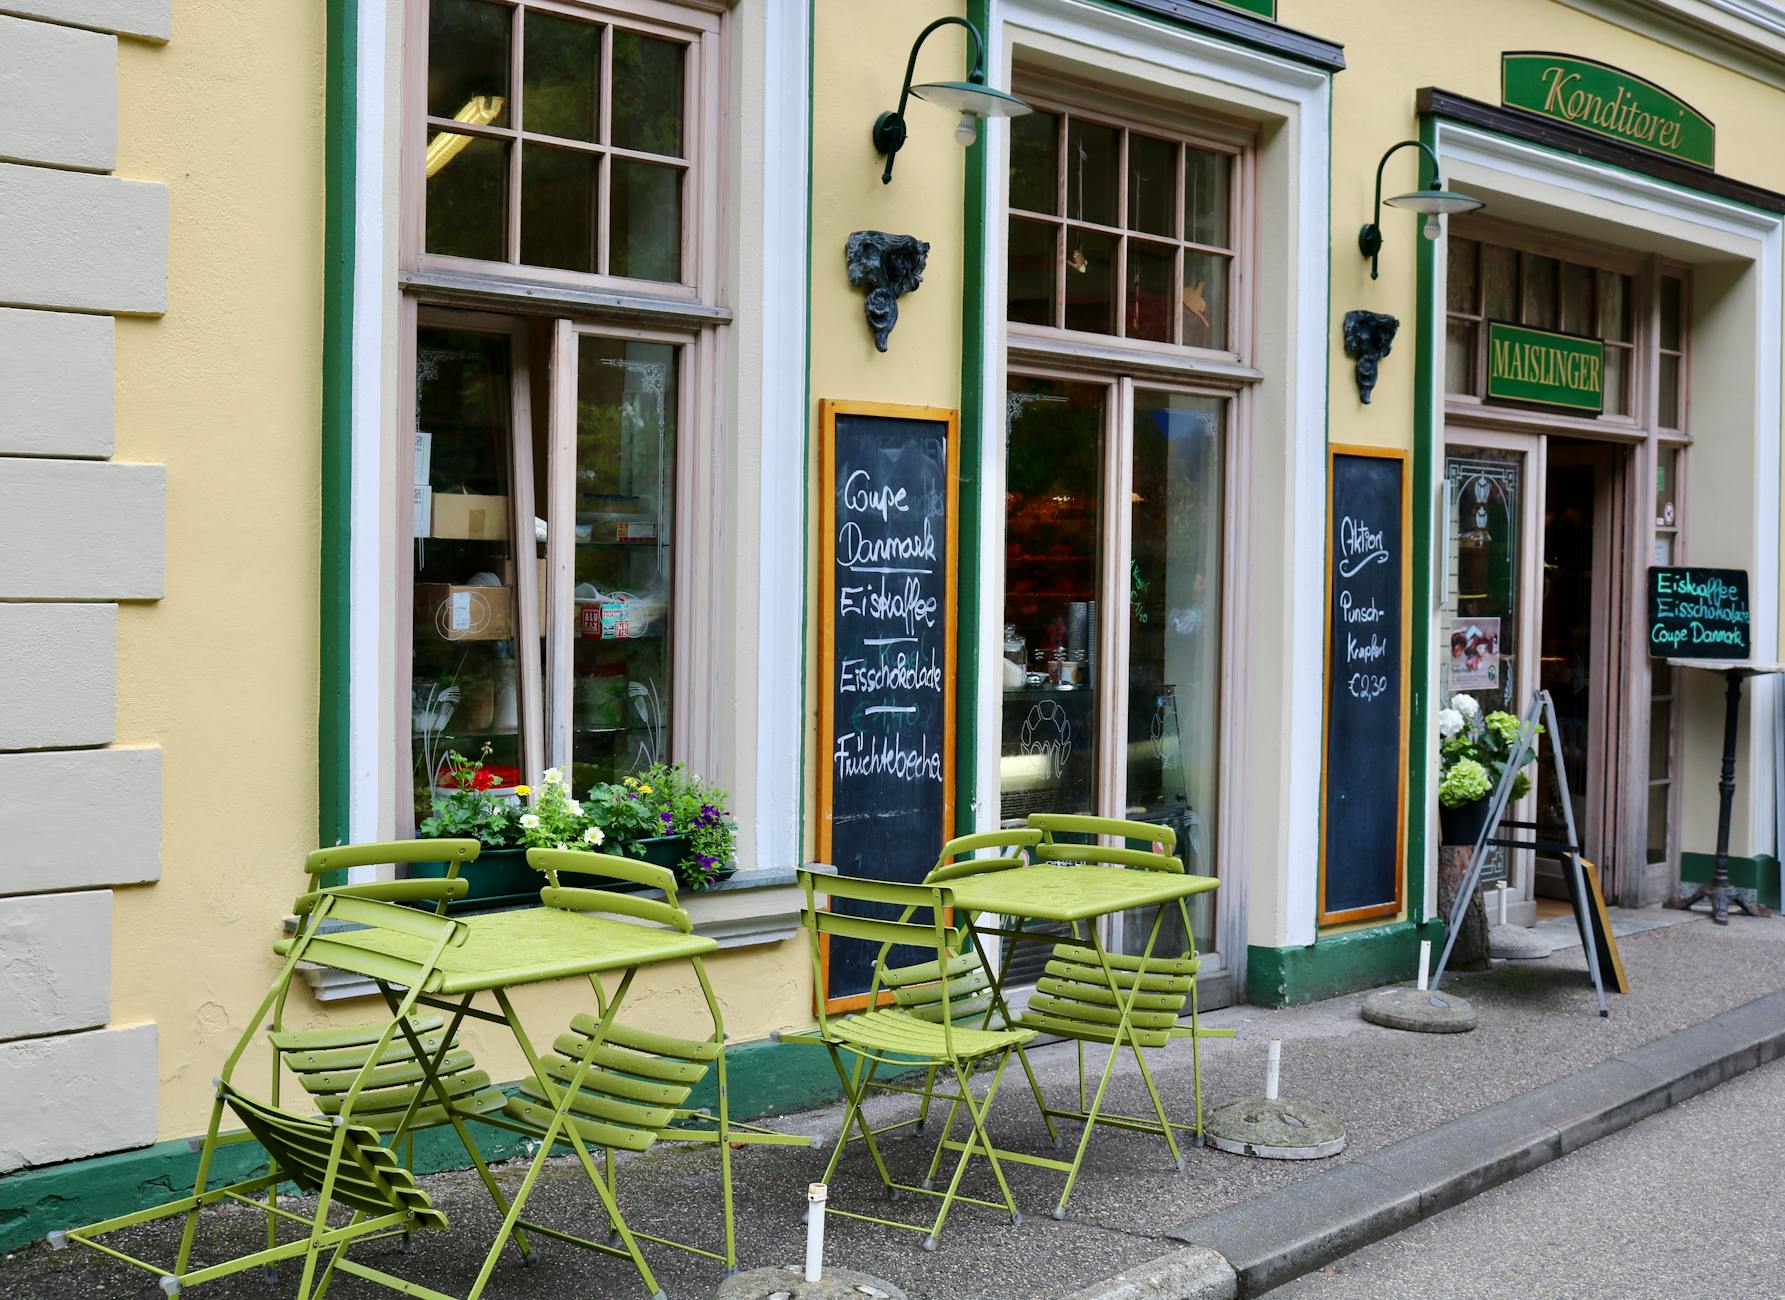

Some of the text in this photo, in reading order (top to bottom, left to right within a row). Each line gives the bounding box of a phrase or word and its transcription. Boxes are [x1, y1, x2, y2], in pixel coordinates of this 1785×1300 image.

[1541, 66, 1684, 151] Konditorei
[1491, 337, 1602, 394] MAISLINGER
[844, 469, 910, 523] Coupe
[836, 516, 937, 567] Danmark
[1340, 515, 1384, 558] Aktion
[840, 575, 938, 636] Eiskaffee
[1339, 589, 1386, 624] Punsch-
[1657, 571, 1740, 607] Eiskaffee
[1651, 620, 1746, 649] Coupe Danmark
[839, 646, 942, 694] Eisschokolade
